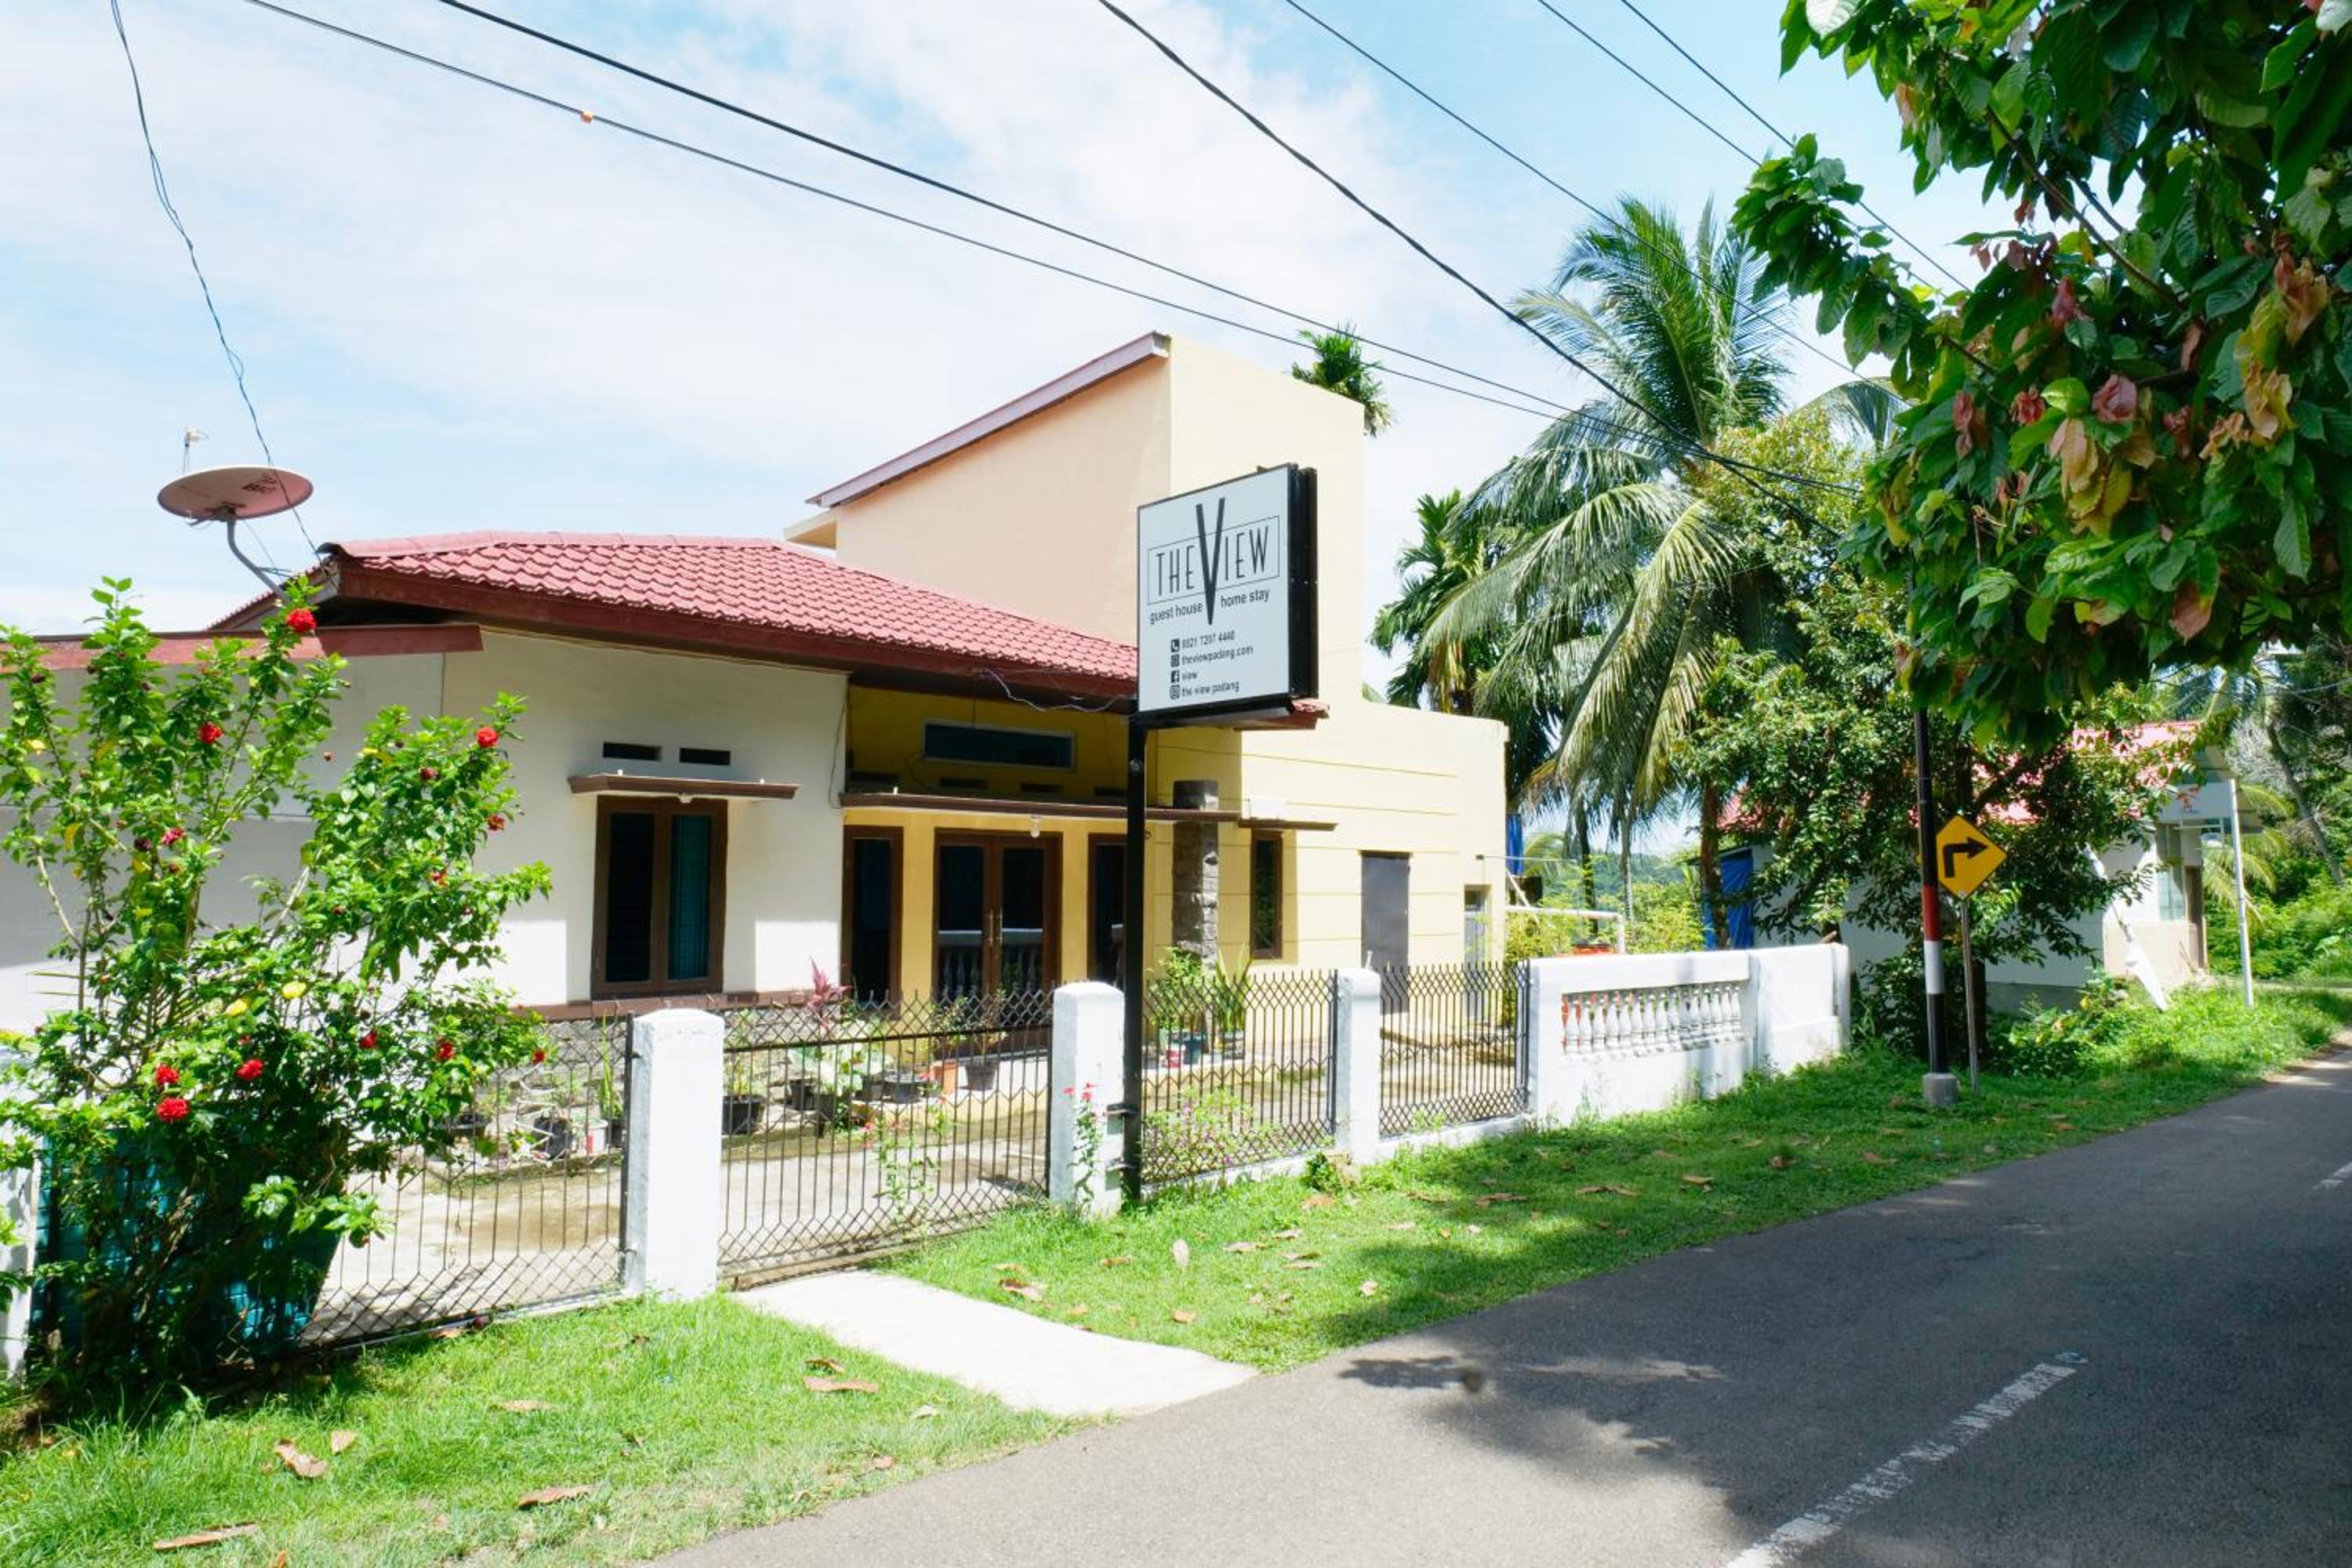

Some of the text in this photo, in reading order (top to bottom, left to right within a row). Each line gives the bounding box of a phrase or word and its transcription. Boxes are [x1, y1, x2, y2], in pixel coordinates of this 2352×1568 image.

[1155, 496, 1269, 625] THE VIEW
[1221, 590, 1269, 608] home stay
[1150, 603, 1203, 625] guest house
[1181, 646, 1254, 665] theviewpadang.com
[1211, 681, 1240, 695] padang
